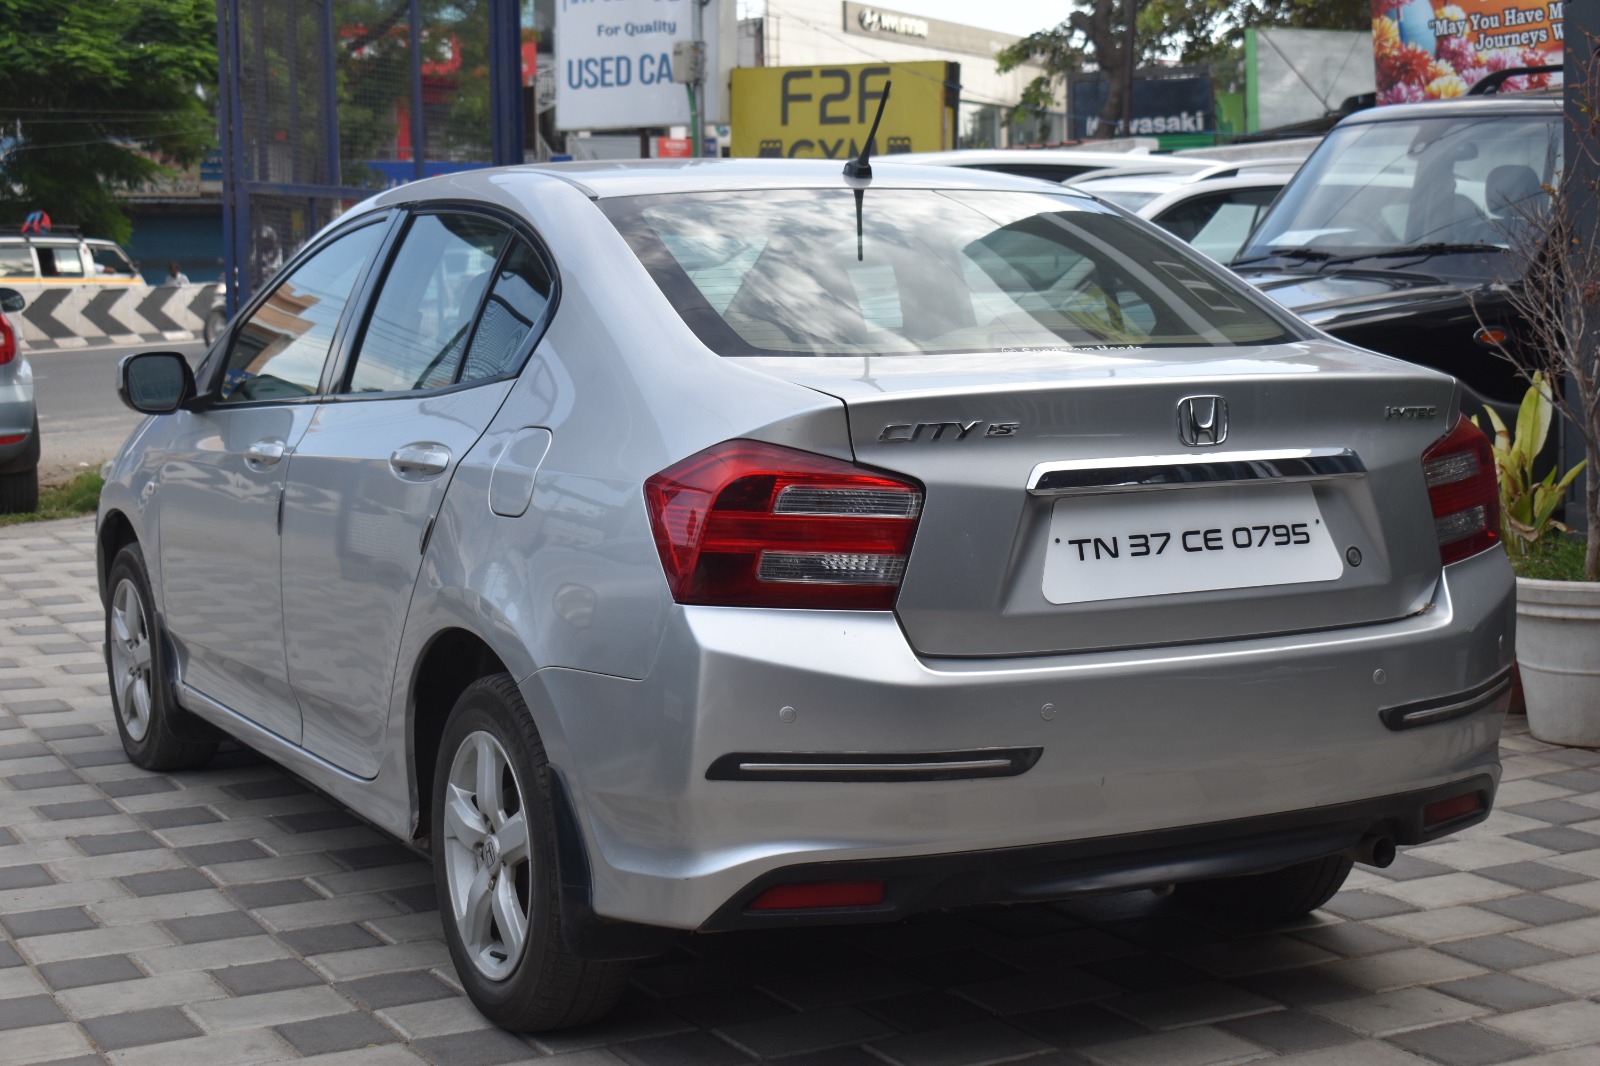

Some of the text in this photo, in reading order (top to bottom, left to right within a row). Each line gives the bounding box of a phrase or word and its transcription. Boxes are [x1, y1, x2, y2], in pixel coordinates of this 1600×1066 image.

[597, 20, 678, 37] For Quality
[1470, 13, 1500, 31] You
[1504, 8, 1544, 27] Have
[1475, 29, 1547, 50] Journeys
[567, 53, 674, 89] USED CA
[781, 66, 891, 127] F2F
[1086, 111, 1205, 136] Kwasaki
[878, 419, 984, 442] CITY
[1068, 523, 1311, 561] TN 37 CE 0795
